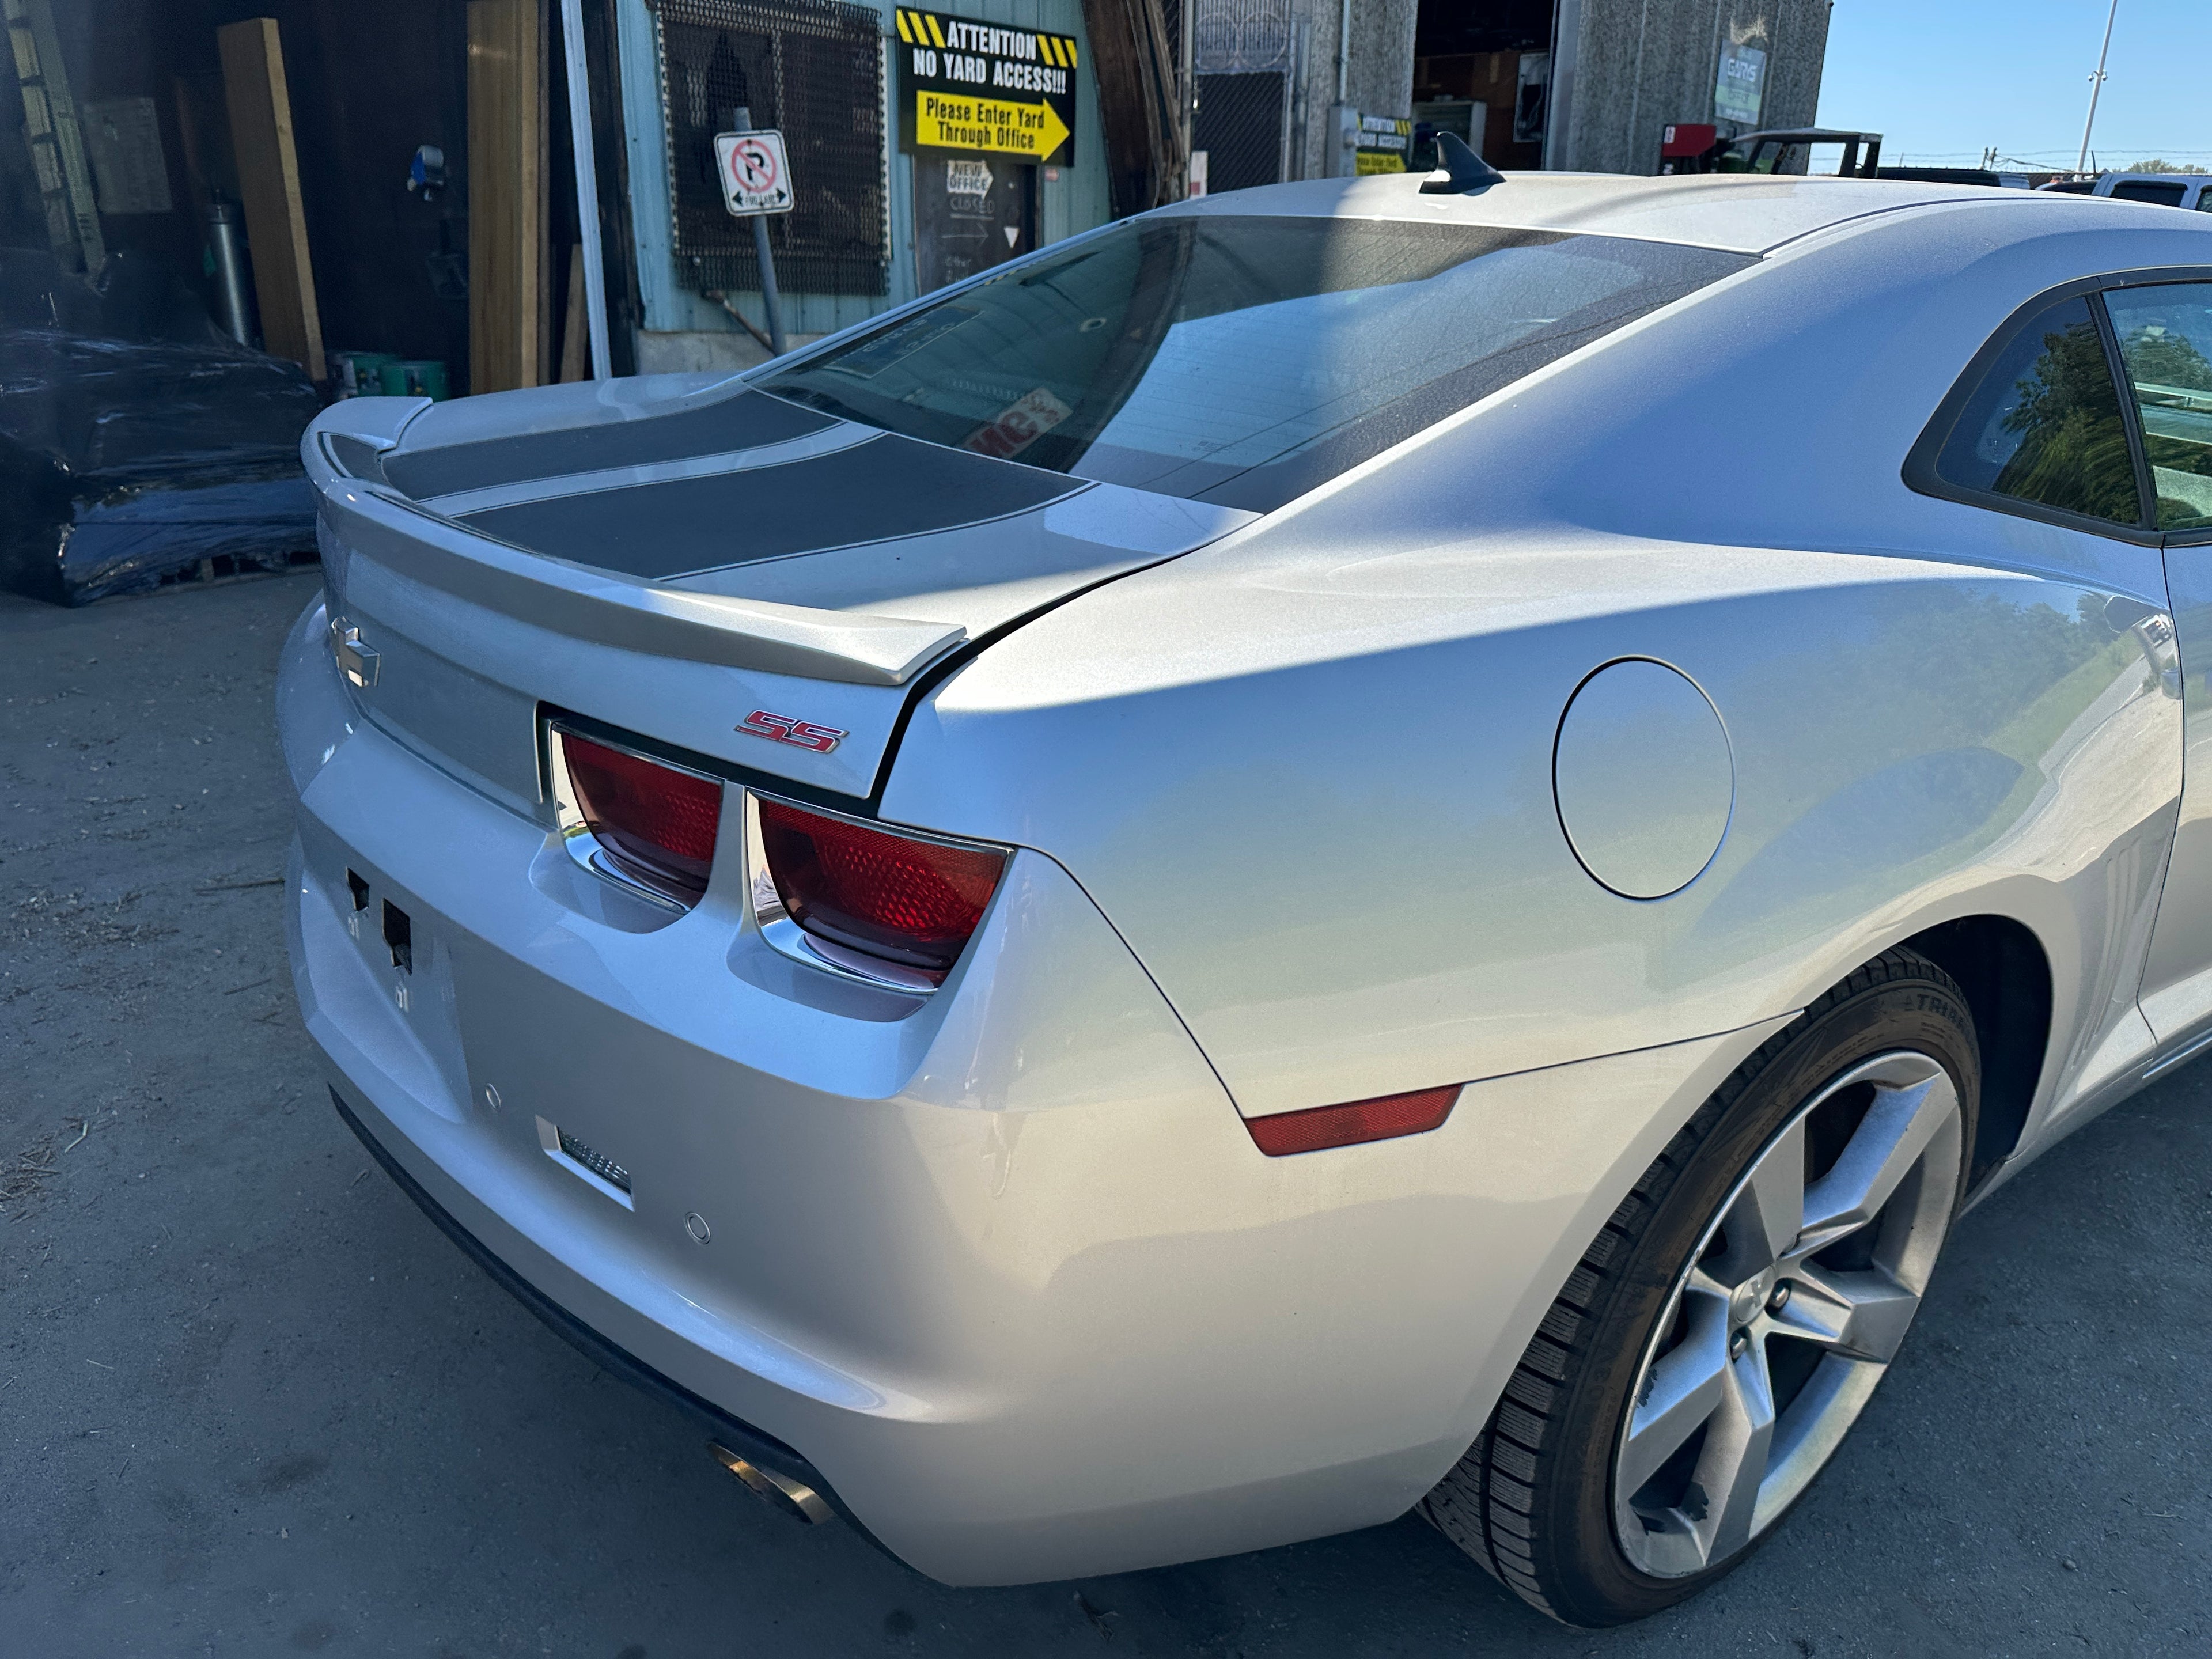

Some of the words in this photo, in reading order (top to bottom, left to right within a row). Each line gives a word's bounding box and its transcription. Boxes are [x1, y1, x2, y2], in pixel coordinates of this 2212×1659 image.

[946, 21, 1036, 60] ATTENTION
[912, 48, 937, 77] NO
[943, 52, 987, 84] YARD
[993, 60, 1066, 94] ACCESS!!!
[926, 97, 971, 122] Please
[976, 103, 1011, 126] Enter
[1017, 107, 1044, 129] Yard
[938, 121, 991, 147] Through
[997, 127, 1035, 150] Office
[951, 175, 987, 190] OFFICE
[733, 709, 850, 753] SS
